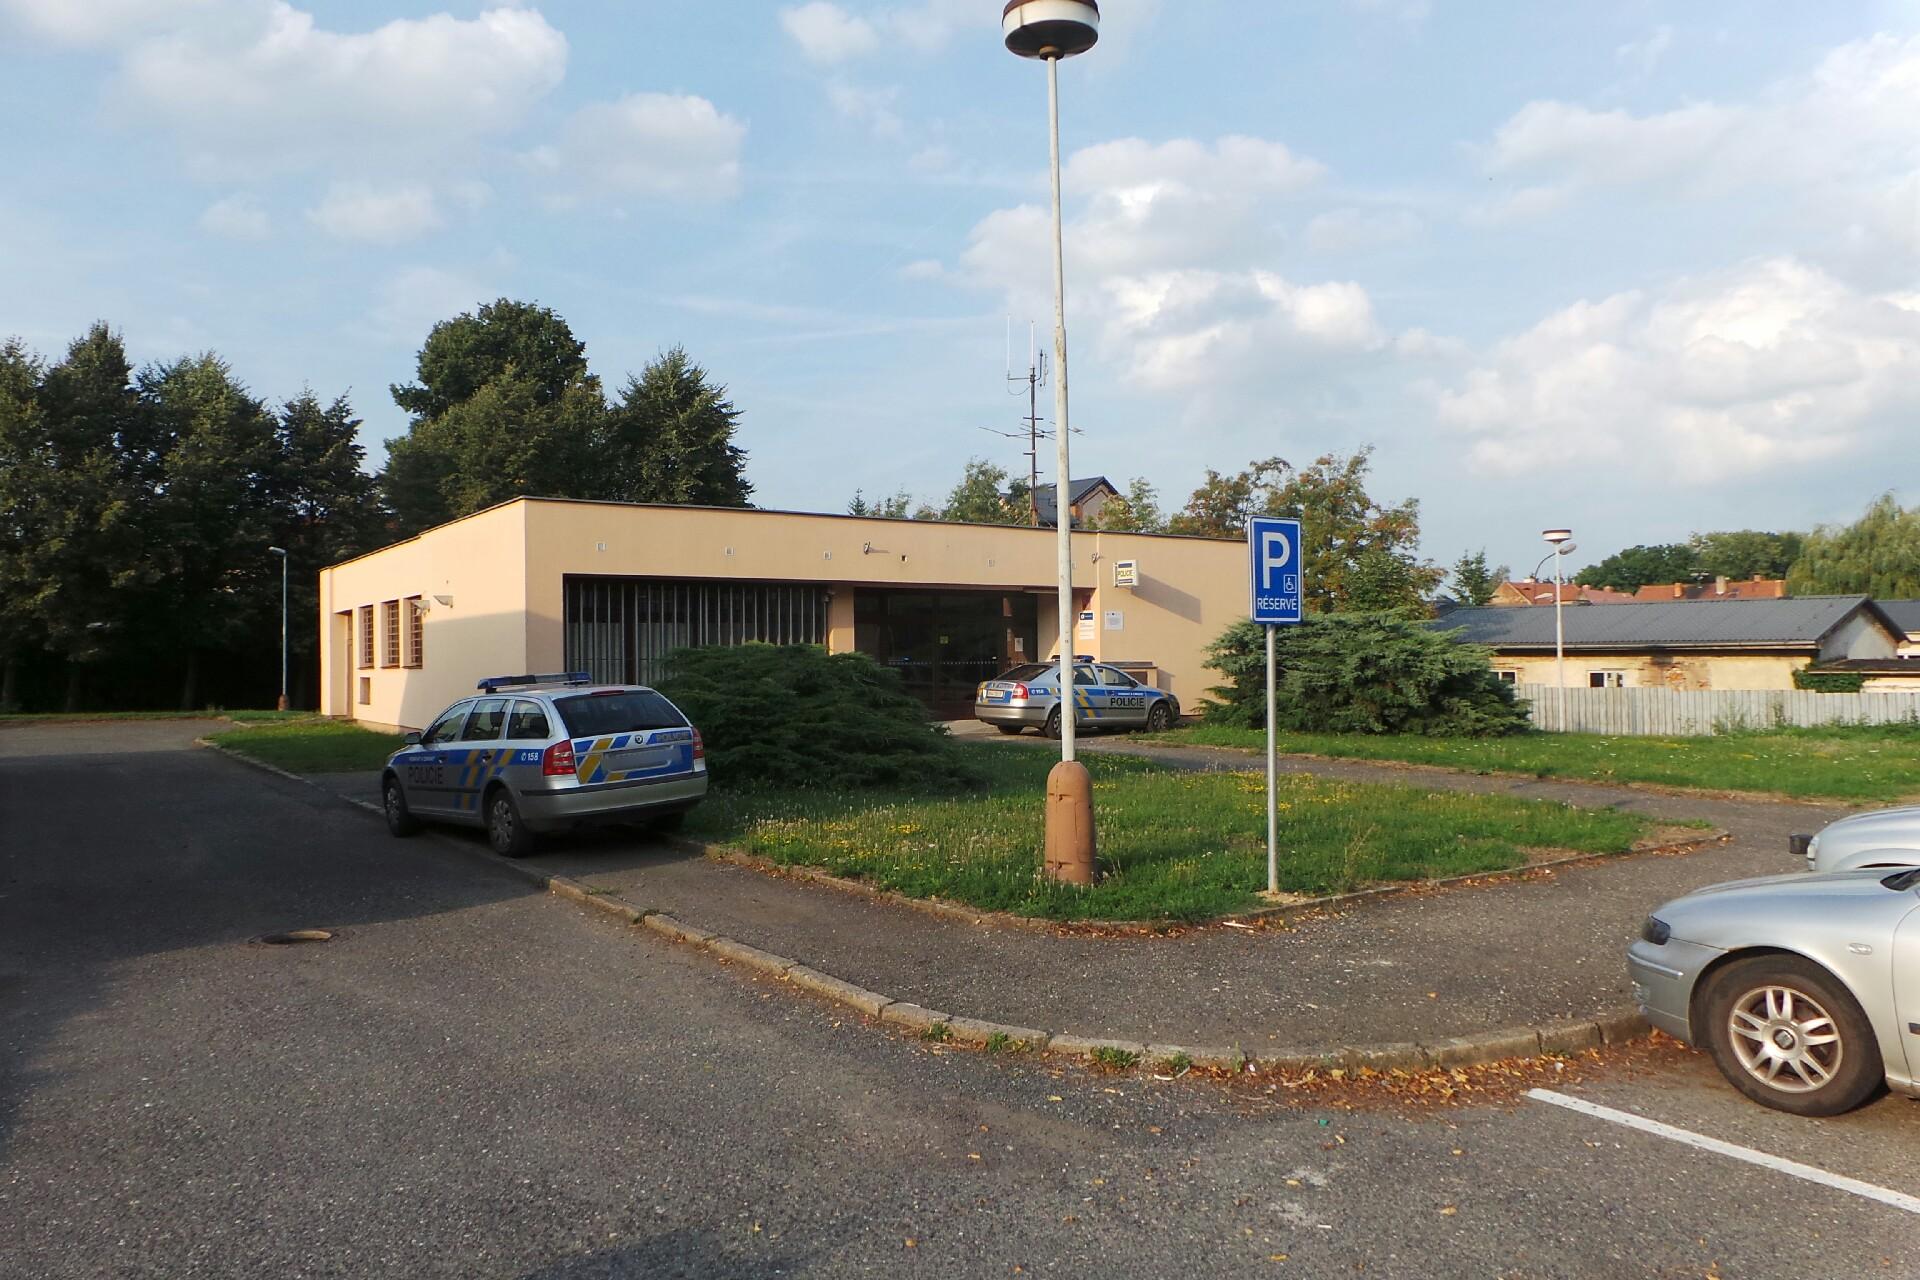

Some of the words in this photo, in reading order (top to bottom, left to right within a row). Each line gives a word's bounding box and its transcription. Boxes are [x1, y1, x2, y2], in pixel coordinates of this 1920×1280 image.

[1262, 531, 1290, 589] P
[1257, 595, 1298, 610] RÉSERVÉ
[1110, 697, 1145, 707] POLICIE
[526, 751, 539, 761] 158
[408, 766, 444, 785] POLICIE
